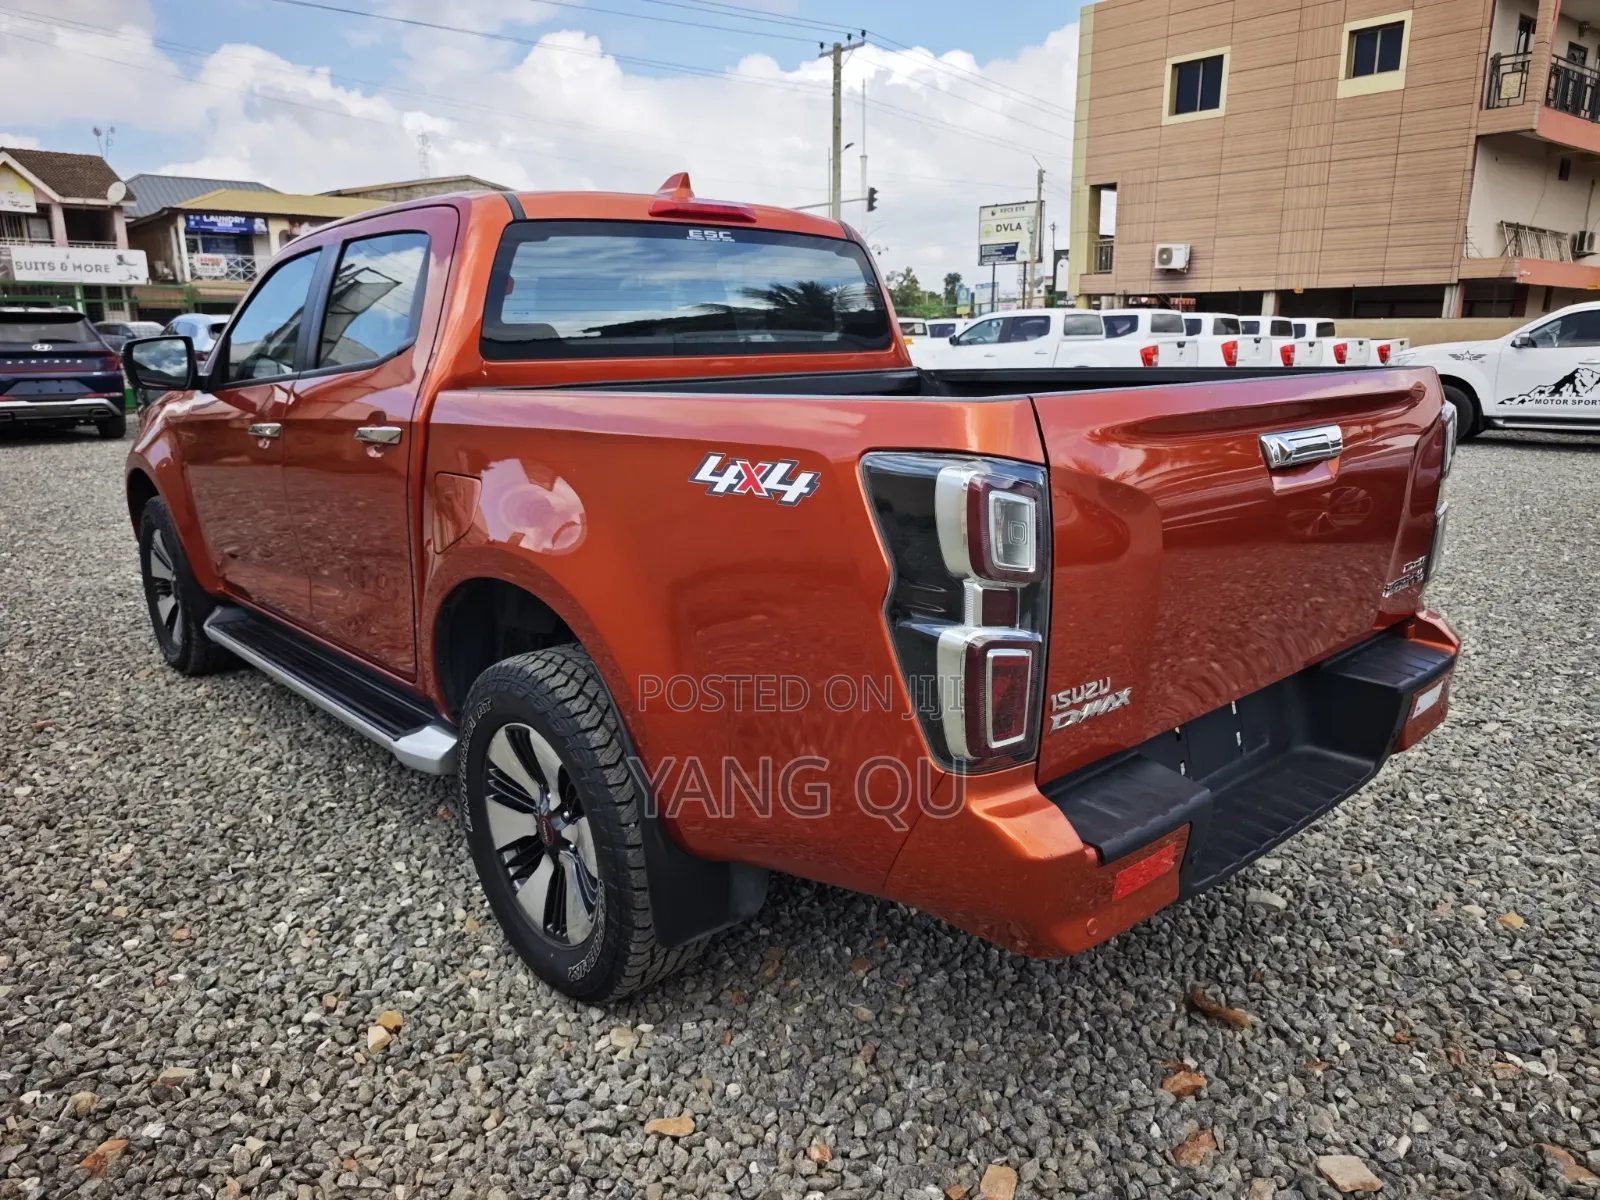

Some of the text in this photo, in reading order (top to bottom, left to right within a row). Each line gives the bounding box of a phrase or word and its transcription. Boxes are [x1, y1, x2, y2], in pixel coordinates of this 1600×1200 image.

[203, 215, 246, 224] LAUNDRY
[995, 222, 1022, 233] DVLA
[688, 229, 732, 239] ESC
[14, 261, 112, 273] SUITS & MORE
[1050, 676, 1111, 713] ISUZU
